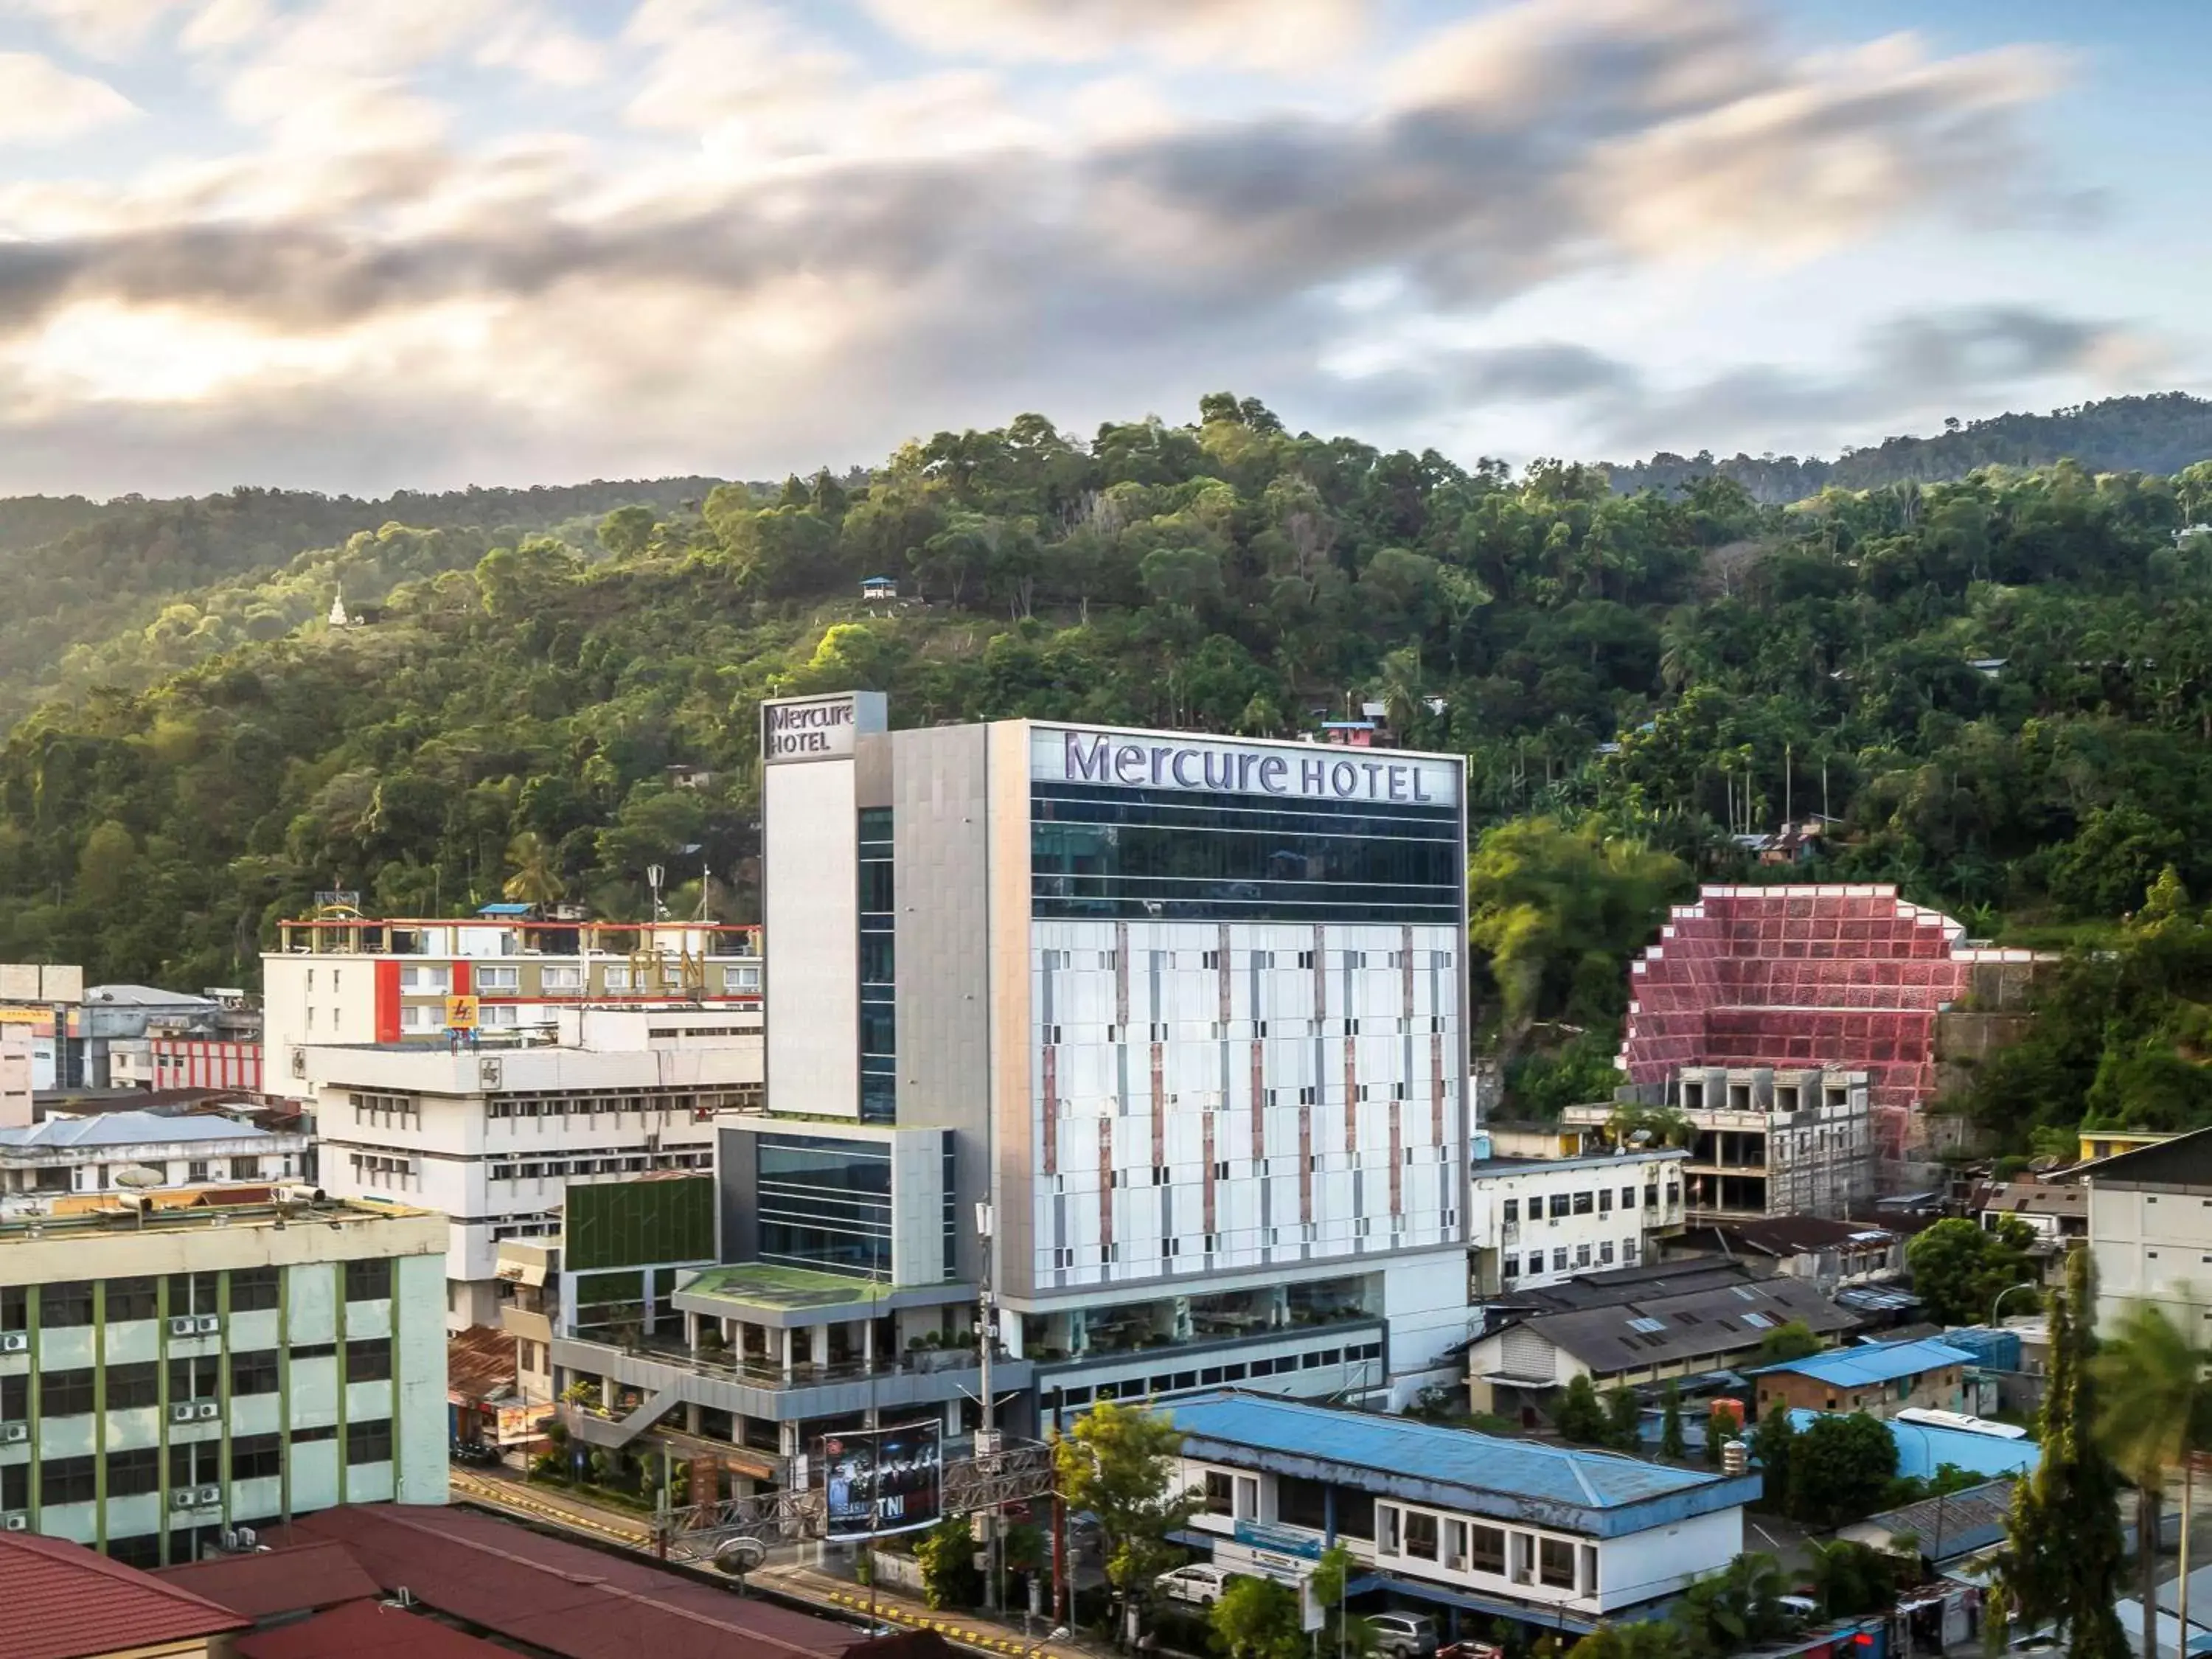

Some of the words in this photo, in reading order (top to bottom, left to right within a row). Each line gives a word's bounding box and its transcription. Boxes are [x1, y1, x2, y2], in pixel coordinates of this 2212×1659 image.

[771, 704, 855, 731] Mercure
[771, 731, 831, 754] HOTEL
[1065, 732, 1288, 793] Mercure
[1301, 758, 1431, 802] HOTEL
[630, 948, 704, 990] PLN
